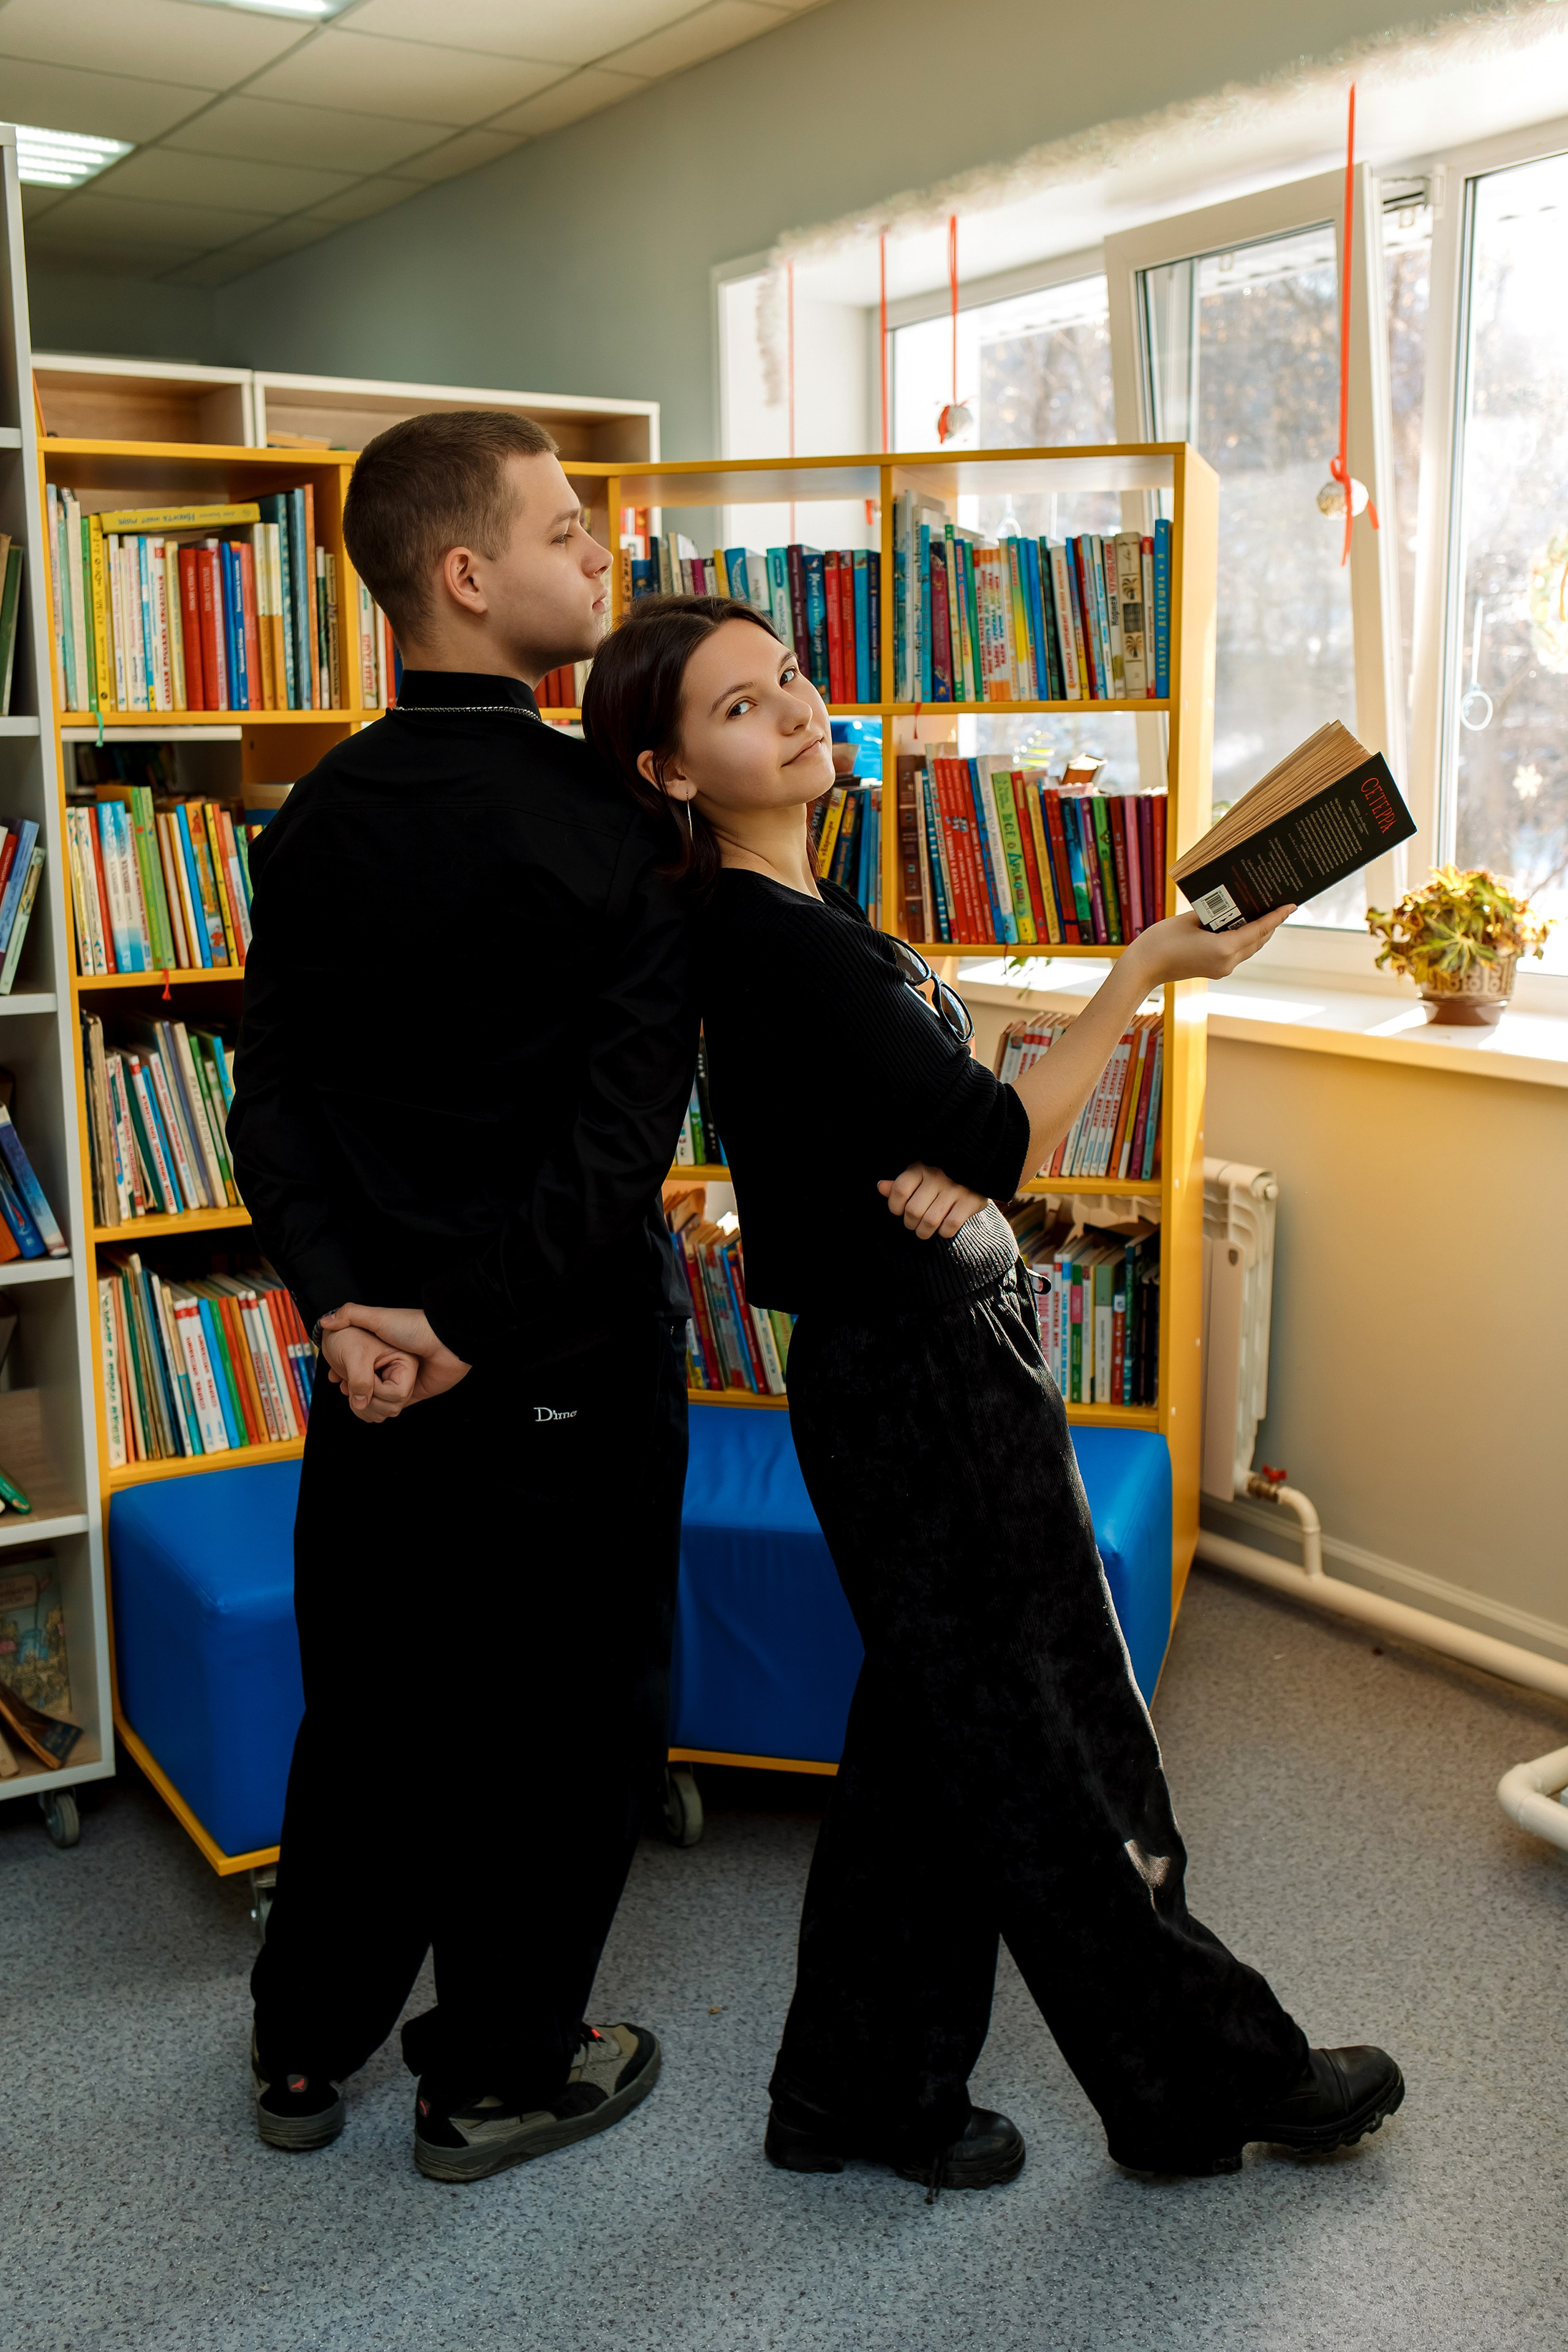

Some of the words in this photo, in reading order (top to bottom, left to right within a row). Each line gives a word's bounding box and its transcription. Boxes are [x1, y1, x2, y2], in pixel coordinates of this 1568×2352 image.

[1110, 595, 1120, 625] Корней
[1361, 777, 1396, 834] СЕТЕРРА
[533, 1407, 578, 1422] Dime
